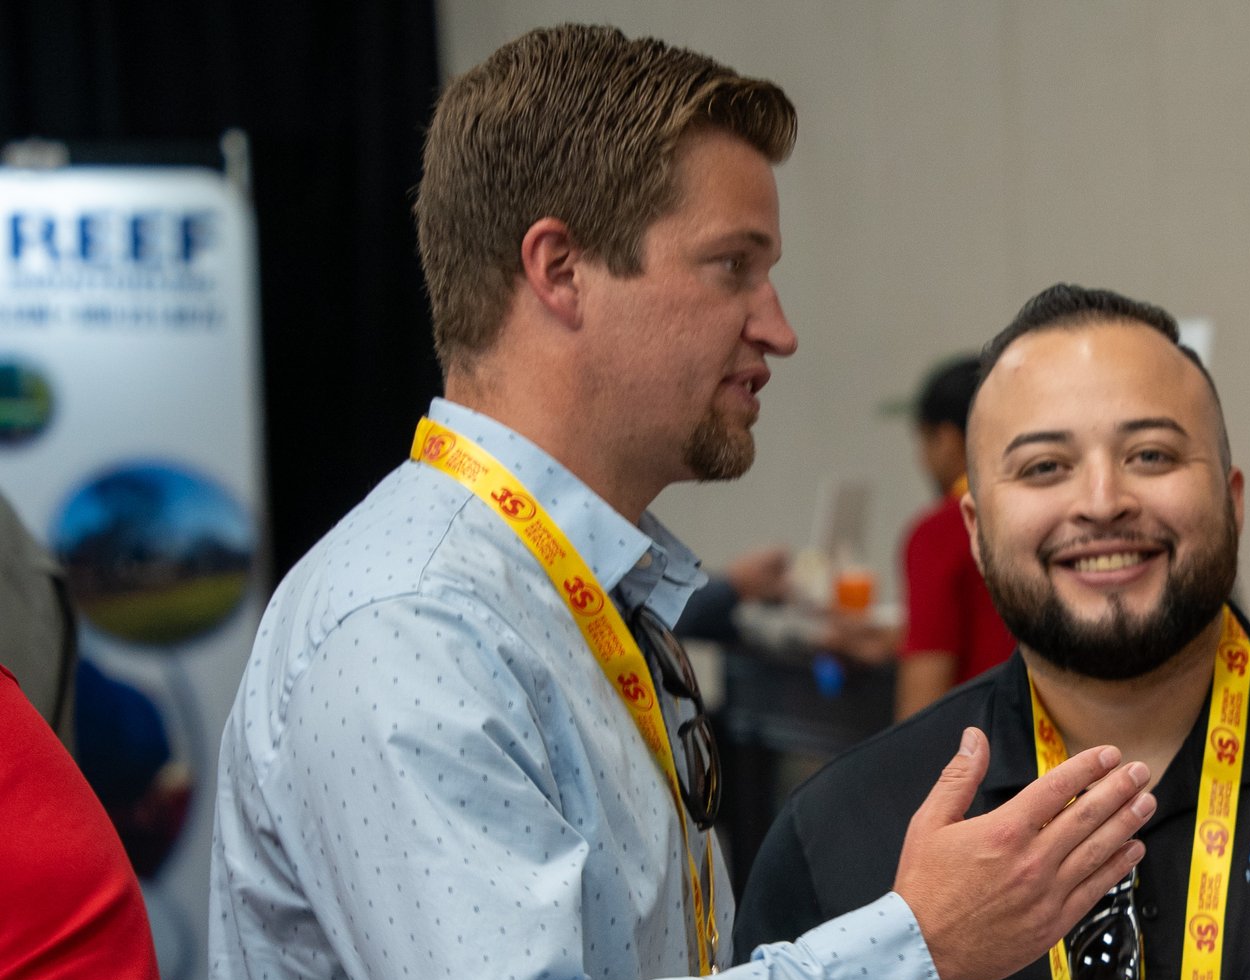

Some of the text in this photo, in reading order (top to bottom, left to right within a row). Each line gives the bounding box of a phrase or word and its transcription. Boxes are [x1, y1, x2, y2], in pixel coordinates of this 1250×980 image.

[563, 575, 596, 610] 3S
[1226, 649, 1249, 677] 3S
[617, 671, 647, 702] 3S
[1216, 737, 1239, 766] 3S
[1206, 829, 1228, 858] 3S
[1196, 923, 1216, 954] 3S
